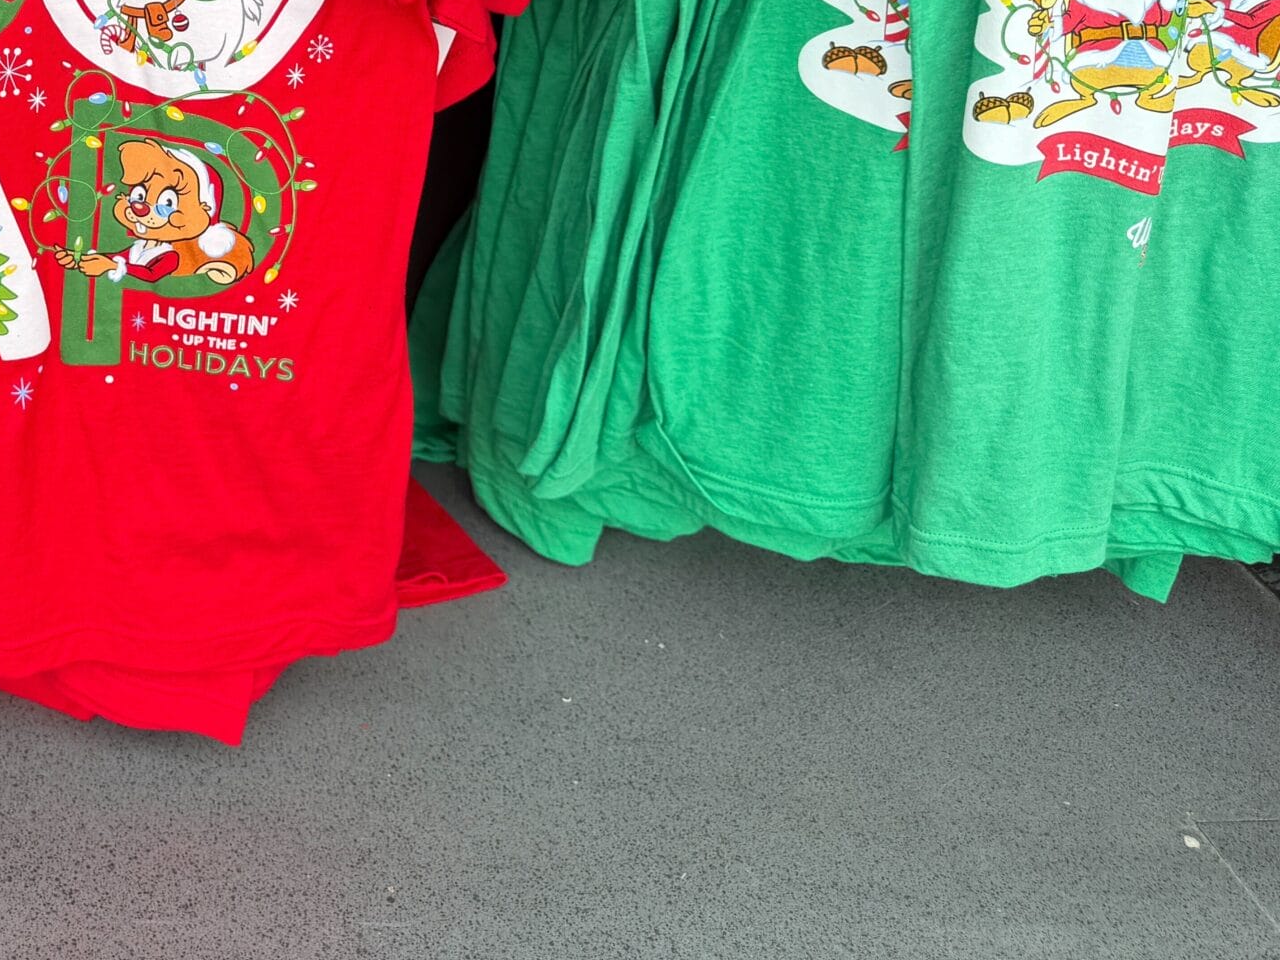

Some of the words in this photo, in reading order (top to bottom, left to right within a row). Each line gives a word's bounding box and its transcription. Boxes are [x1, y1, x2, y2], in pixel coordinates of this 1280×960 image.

[1056, 143, 1158, 183] Lightin'
[152, 303, 278, 336] LIGHTIN'
[182, 334, 204, 346] UP
[207, 336, 236, 350] THE
[129, 341, 294, 382] HOLIDAYS
